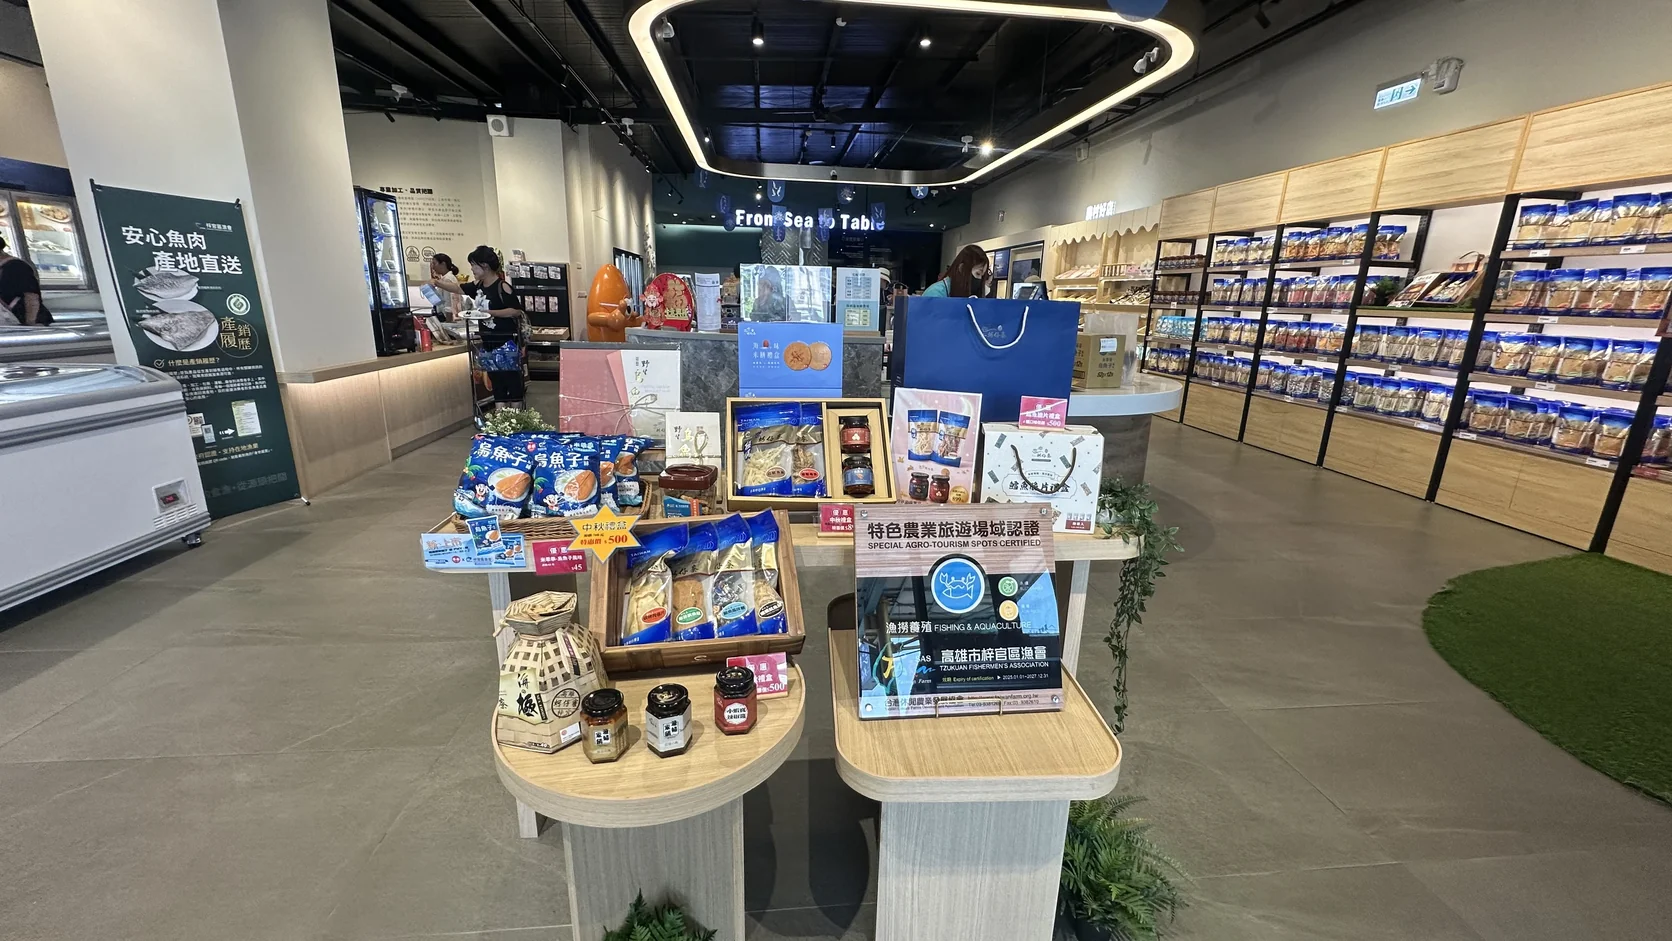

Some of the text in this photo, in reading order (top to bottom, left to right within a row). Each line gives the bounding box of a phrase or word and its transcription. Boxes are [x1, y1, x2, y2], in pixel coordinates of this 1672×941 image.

[783, 211, 814, 228] Sea
[840, 214, 885, 231] Table
[121, 226, 206, 250] 安心魚肉
[153, 251, 243, 275] 產地直送
[473, 441, 529, 467] 烏魚子
[534, 451, 584, 468] 烏魚子
[582, 520, 627, 531] 中秋禮盒
[867, 520, 1040, 540] 特色農業旅遊場域認證
[604, 534, 628, 544] $500
[867, 538, 1041, 550] SPECIAL AGRO-TOURISM SPOTS CERTIFIED
[571, 563, 583, 571] $45
[885, 621, 933, 634] 漁撈養殖
[934, 620, 1032, 632] FISHING & AQUACULTURE
[941, 645, 1047, 663] 高雄市梓官區漁會
[969, 662, 1009, 670] FISHERMEN'S
[1009, 661, 1049, 669] ASSOCIATION
[754, 673, 773, 683] 禮盒
